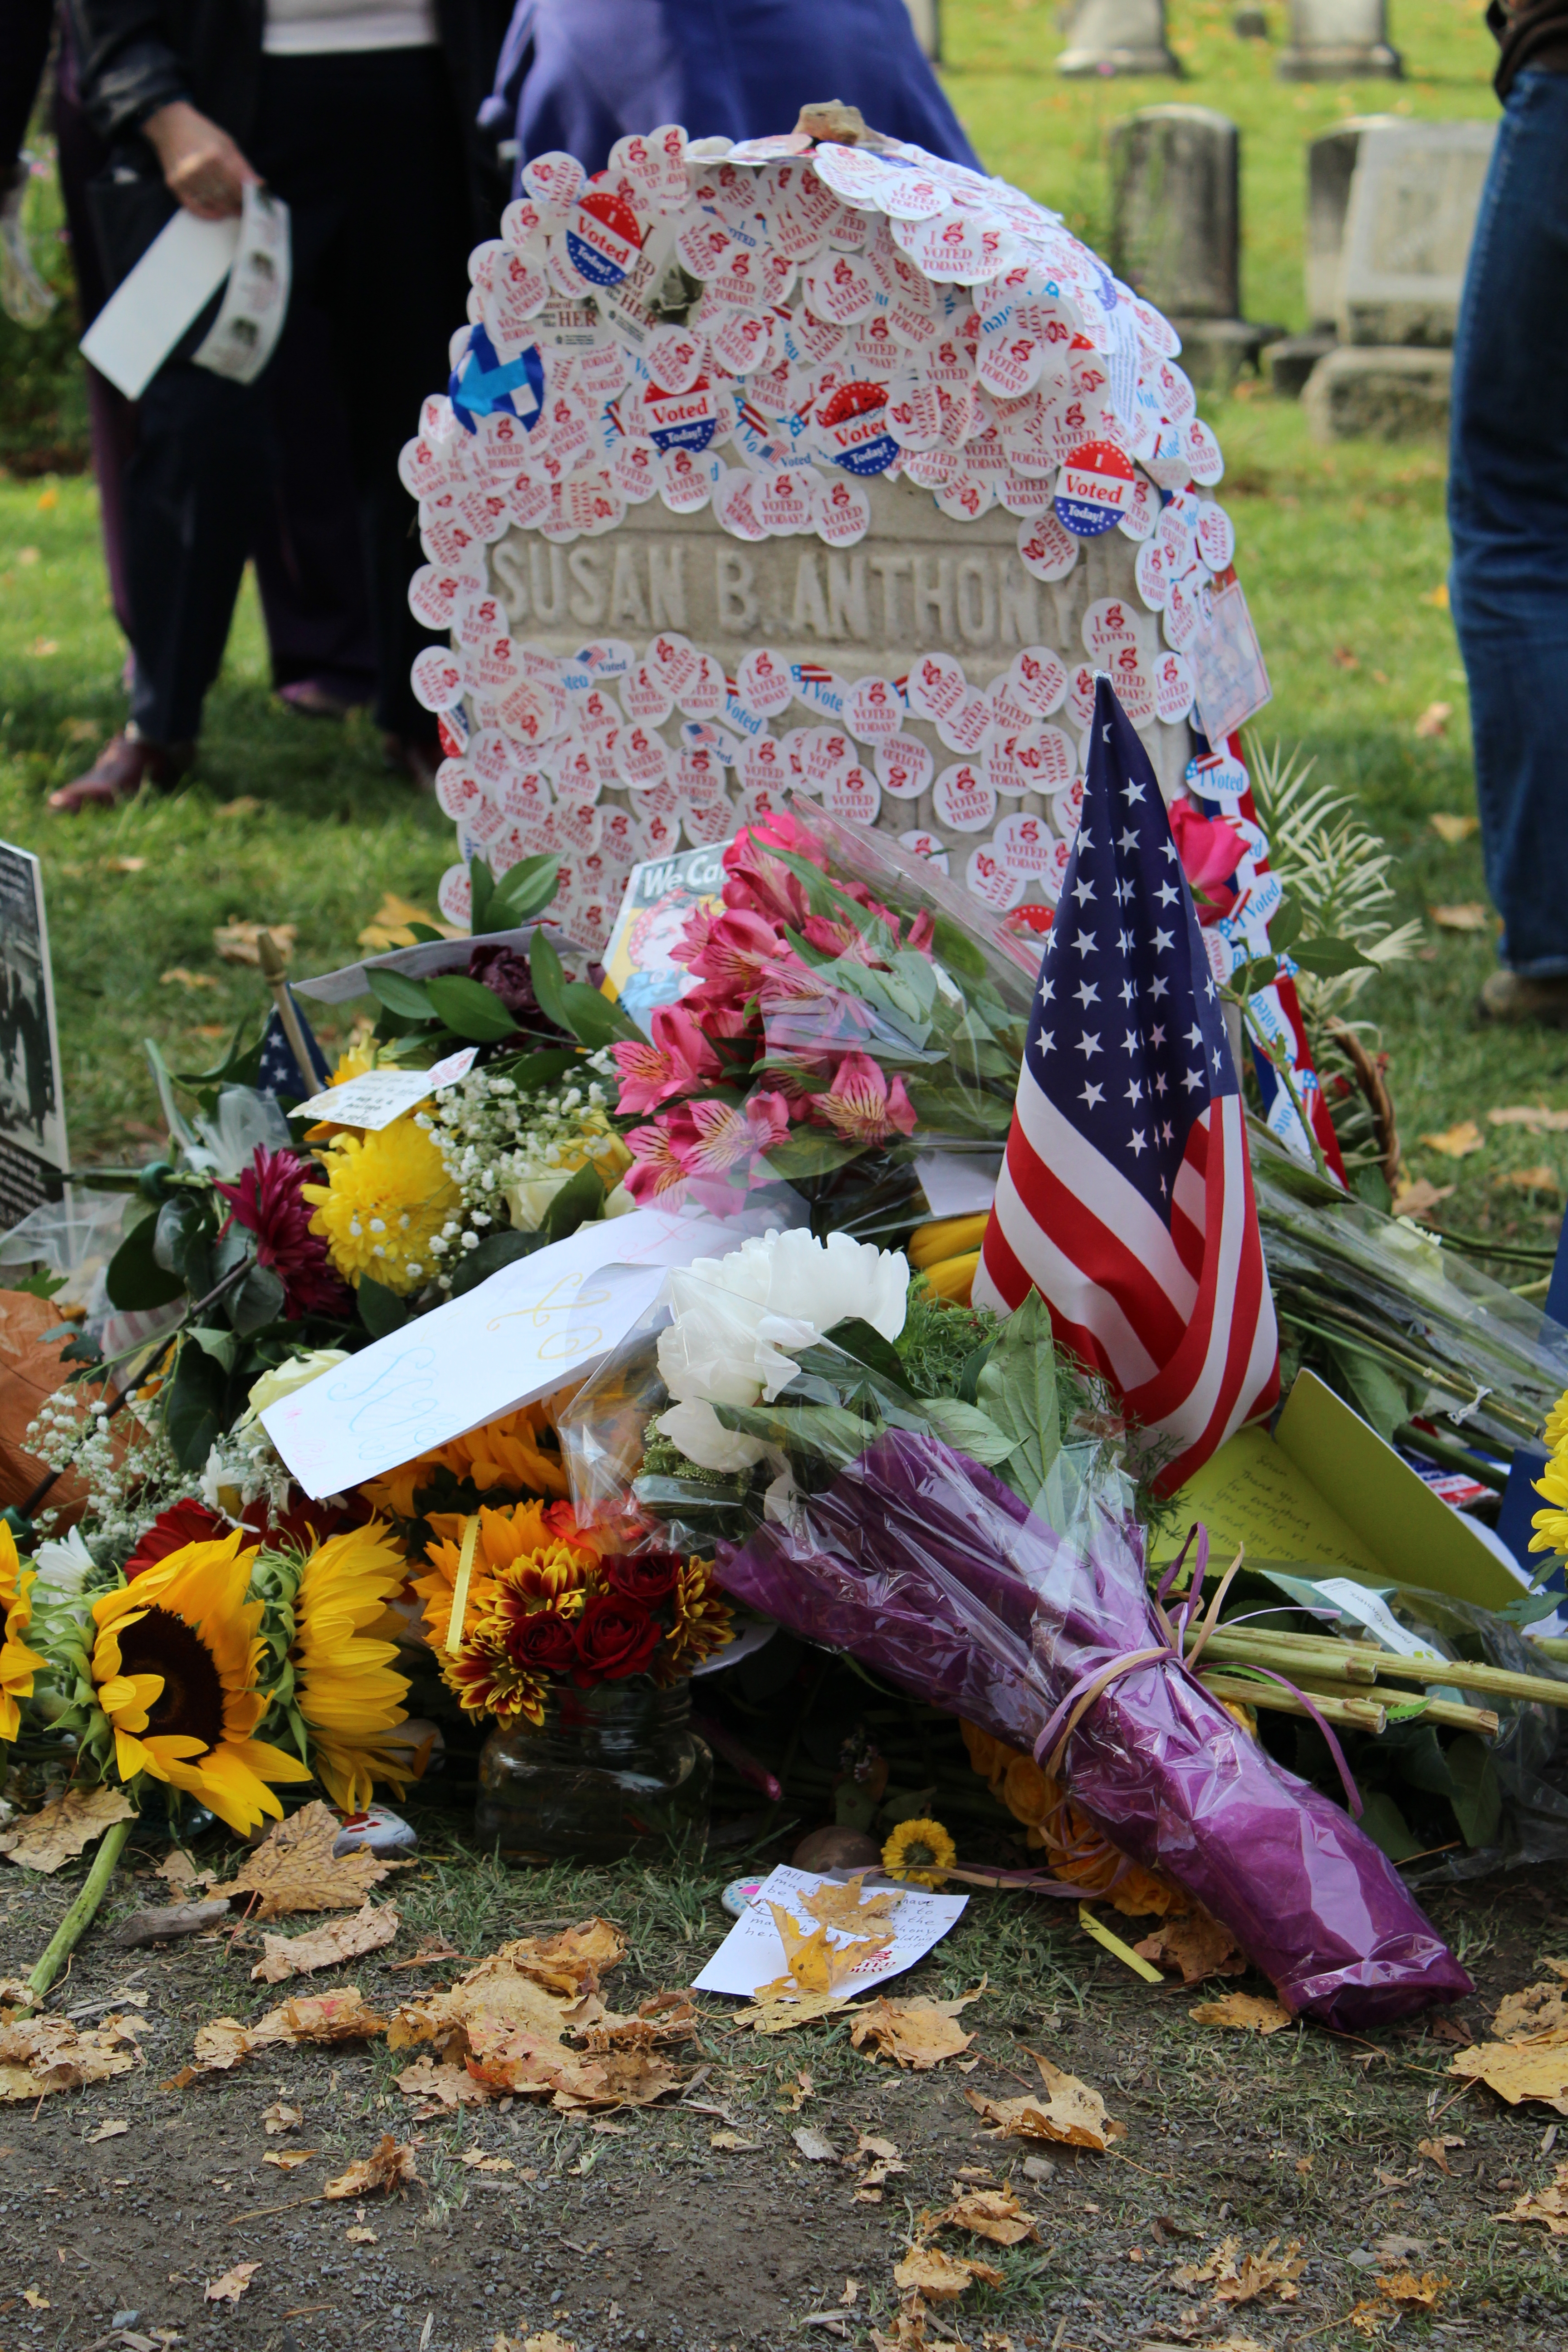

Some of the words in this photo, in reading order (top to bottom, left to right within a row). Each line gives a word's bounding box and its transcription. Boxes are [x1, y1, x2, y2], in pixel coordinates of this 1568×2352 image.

[891, 198, 938, 211] TODAY!
[893, 189, 941, 205] VOTED
[607, 211, 617, 223] I
[578, 215, 631, 265] Voted
[930, 230, 935, 245] I
[578, 244, 613, 275] Today!
[679, 235, 708, 276] TODAY!
[689, 227, 715, 271] VOTED
[923, 245, 973, 259] VOTED
[921, 259, 970, 272] TODAY!
[506, 275, 541, 304] VOTED
[716, 277, 756, 294] VOTED
[826, 278, 869, 308] VOTED
[715, 288, 754, 306] TODAY!
[833, 290, 874, 321] TODAY!
[558, 311, 597, 327] HER
[620, 293, 657, 331] HER
[897, 301, 936, 334] VOTED
[890, 310, 930, 342] TODAY!
[715, 334, 748, 368] TODAY!
[722, 324, 755, 362] VOTED
[855, 342, 897, 355] VOTED
[648, 352, 680, 389] TODAY!
[657, 343, 687, 383] VOTED
[926, 368, 969, 380] VOTED
[989, 349, 1029, 382] VOTED
[980, 362, 1022, 395] TODAY!
[1164, 384, 1186, 409] VOTED
[652, 397, 710, 424] Voted
[912, 389, 929, 438] VOTED
[941, 397, 966, 435] VOTED
[551, 419, 585, 444] VOTED
[666, 426, 702, 444] Today!
[1053, 430, 1096, 445] VOTED
[485, 444, 524, 456] VOTED
[554, 431, 588, 456] TODAY!
[850, 442, 888, 465] Today!
[1186, 446, 1215, 462] VOTED
[488, 457, 525, 469] TODAY!
[780, 453, 811, 468] Voted
[965, 459, 1007, 469] TODAY!
[1011, 451, 1054, 468] TODAY!
[1095, 453, 1103, 467] I
[615, 461, 653, 485] VOTED
[666, 472, 705, 492] VOTED
[1004, 479, 1049, 491] VOTED
[1066, 474, 1123, 504] Voted
[510, 484, 544, 513] VOTED
[669, 488, 708, 505] TODAY!
[761, 500, 804, 511] VOTED
[1007, 494, 1049, 505] TODAY!
[726, 503, 761, 540] TODAY!
[763, 513, 804, 524] TODAY!
[822, 506, 862, 526] VOTED
[1068, 503, 1106, 523] Today!
[826, 519, 867, 539] TODAY!
[1043, 513, 1076, 558] TODAY!
[434, 521, 461, 564] VOTED
[1034, 520, 1065, 566] VOTED
[1142, 569, 1166, 588] VOTED
[421, 582, 454, 617] VOTED
[492, 542, 687, 628] SUSAN
[790, 553, 1087, 647] ANTHONY
[1094, 615, 1100, 631] I
[1171, 603, 1192, 634] VOTED
[1092, 631, 1135, 644] VOTED
[479, 659, 518, 676] VOTED
[598, 660, 627, 672] Voted
[662, 648, 690, 685] VOTED
[670, 657, 698, 695] TODAY!
[746, 674, 786, 696] VOTED
[803, 676, 811, 695] I
[917, 686, 929, 698] I
[926, 671, 958, 709] VOTED
[1018, 681, 1030, 692] I
[1028, 663, 1056, 703] VOTED
[1038, 670, 1067, 712] TODAY!
[1157, 681, 1189, 702] VOTED
[505, 693, 538, 724] VOTED
[631, 702, 667, 715] TODAY!
[681, 698, 718, 708] TODAY!
[751, 686, 789, 709] TODAY!
[934, 681, 965, 719] TODAY!
[1160, 696, 1192, 716] TODAY!
[726, 693, 763, 735] Voted
[853, 708, 896, 720] VOTED
[954, 700, 983, 741] VOTED
[993, 696, 1032, 725] VOTED
[580, 716, 616, 732] VOTED
[854, 722, 896, 732] TODAY!
[963, 709, 992, 749] TODAY!
[884, 737, 926, 759] TODAY!
[1039, 735, 1057, 783] VOTED
[1051, 732, 1069, 779] TODAY!
[625, 749, 663, 770] VOTED
[882, 748, 925, 771] VOTED
[630, 760, 668, 783] TODAY!
[676, 771, 718, 786] VOTED
[745, 764, 785, 779] VOTED
[1200, 767, 1205, 787] I
[1210, 769, 1244, 791] Voted
[678, 786, 717, 799] TODAY!
[832, 794, 874, 806] VOTED
[945, 782, 953, 797] I
[945, 791, 989, 810] VOTED
[506, 791, 544, 811] VOTED
[951, 804, 991, 823] TODAY!
[561, 811, 593, 843] VOTED
[1009, 827, 1014, 842] I
[1005, 843, 1048, 857] VOTED
[1006, 856, 1047, 871] TODAY!
[643, 863, 685, 898] We
[975, 879, 988, 890] I
[1235, 912, 1247, 929] I
[1244, 878, 1279, 918] Voted
[1207, 933, 1227, 980] TODAY!
[1242, 1470, 1273, 1491] Thank
[1277, 1491, 1298, 1504] you
[1211, 1489, 1236, 1504] you
[1238, 1504, 1262, 1519] did
[1268, 1518, 1286, 1530] for
[1227, 1479, 1243, 1492] for
[1250, 1497, 1310, 1530] everything
[1220, 1514, 1245, 1529] did
[1246, 1531, 1269, 1545] you
[774, 1878, 814, 1895] much
[779, 1870, 803, 1880] All
[902, 1894, 934, 1906] have
[767, 1886, 786, 1896] be
[908, 1916, 935, 1926] the
